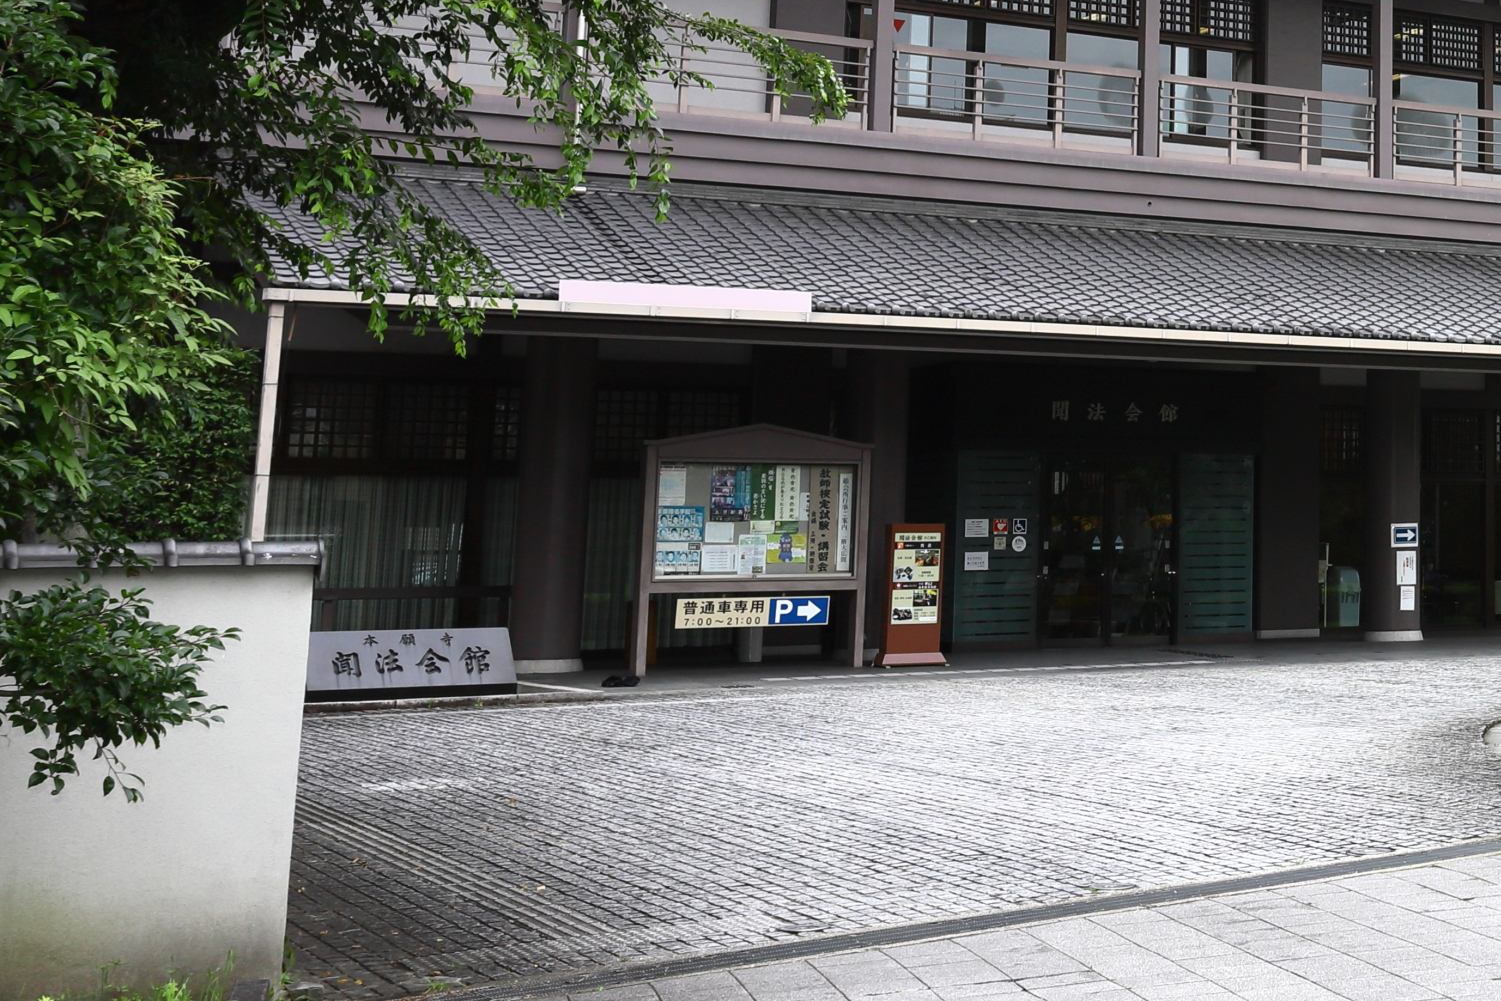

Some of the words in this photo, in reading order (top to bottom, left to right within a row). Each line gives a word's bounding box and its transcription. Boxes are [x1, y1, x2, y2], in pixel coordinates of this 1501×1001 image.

[1051, 400, 1179, 422] 聞法会館
[817, 468, 832, 572] 教師検定試験・講習会
[683, 600, 765, 615] 普通車専用
[774, 600, 794, 624] P
[363, 632, 454, 647] 本願寺
[332, 646, 491, 678] 聞法会館
